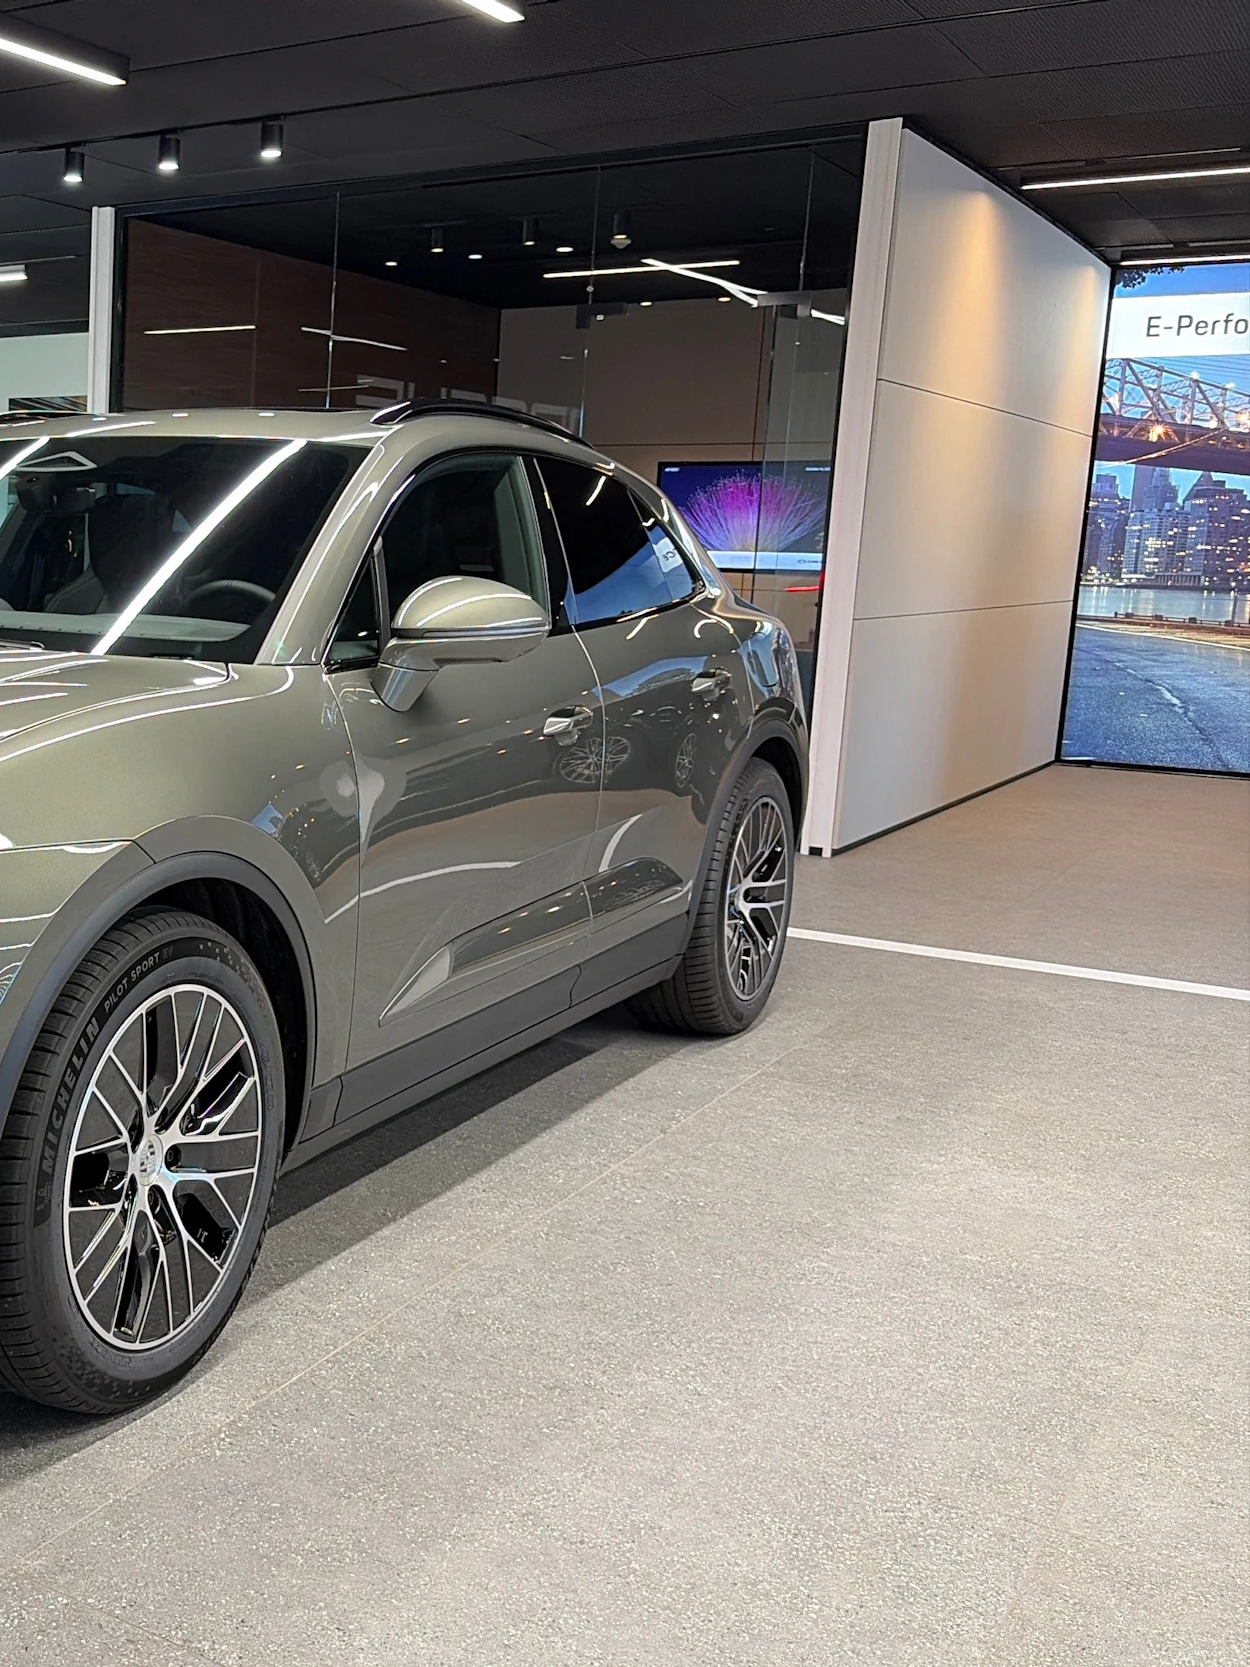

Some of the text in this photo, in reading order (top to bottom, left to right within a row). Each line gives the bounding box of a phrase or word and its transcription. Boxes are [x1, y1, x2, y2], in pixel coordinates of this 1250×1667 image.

[1146, 312, 1249, 338] E-Perfo
[41, 1016, 101, 1175] MICHELIN
[104, 977, 129, 1013] PILOT
[130, 951, 160, 982] SPORT
